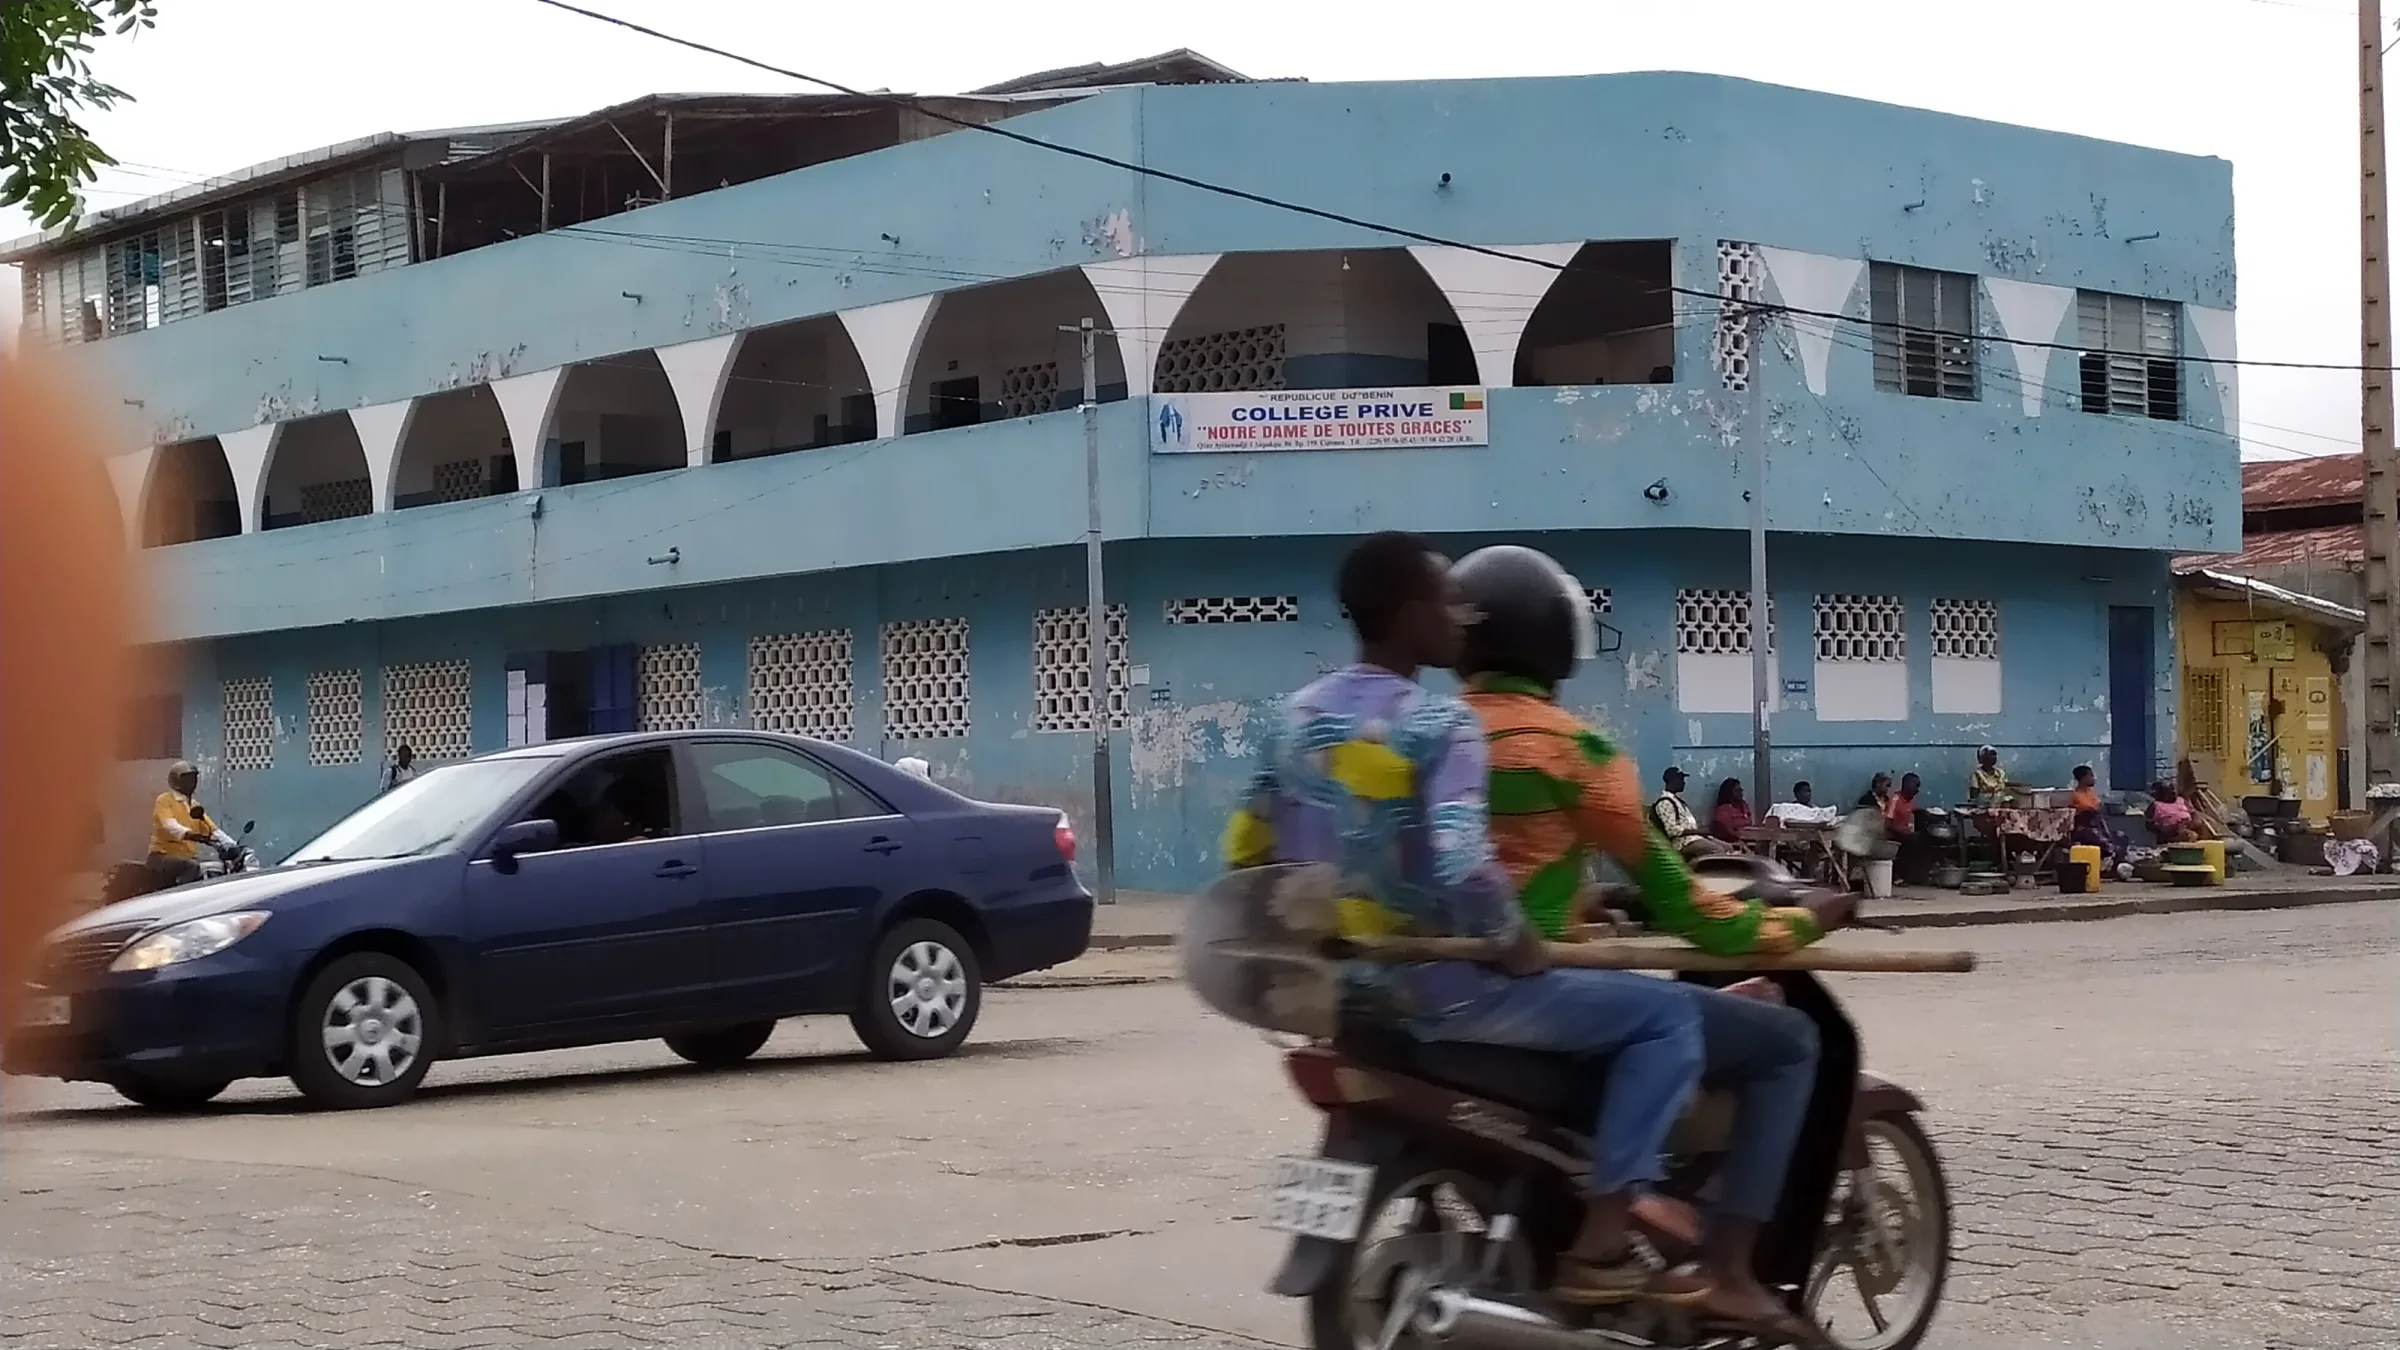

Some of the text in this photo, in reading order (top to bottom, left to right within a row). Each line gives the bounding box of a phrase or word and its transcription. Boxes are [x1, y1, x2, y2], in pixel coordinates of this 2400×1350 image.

[1362, 391, 1394, 400] BENIN
[1231, 402, 1434, 422] COLLEGE PRIVE
[1262, 423, 1309, 439] DAME
[1313, 422, 1333, 438] DE
[1337, 421, 1395, 437] TOUTES
